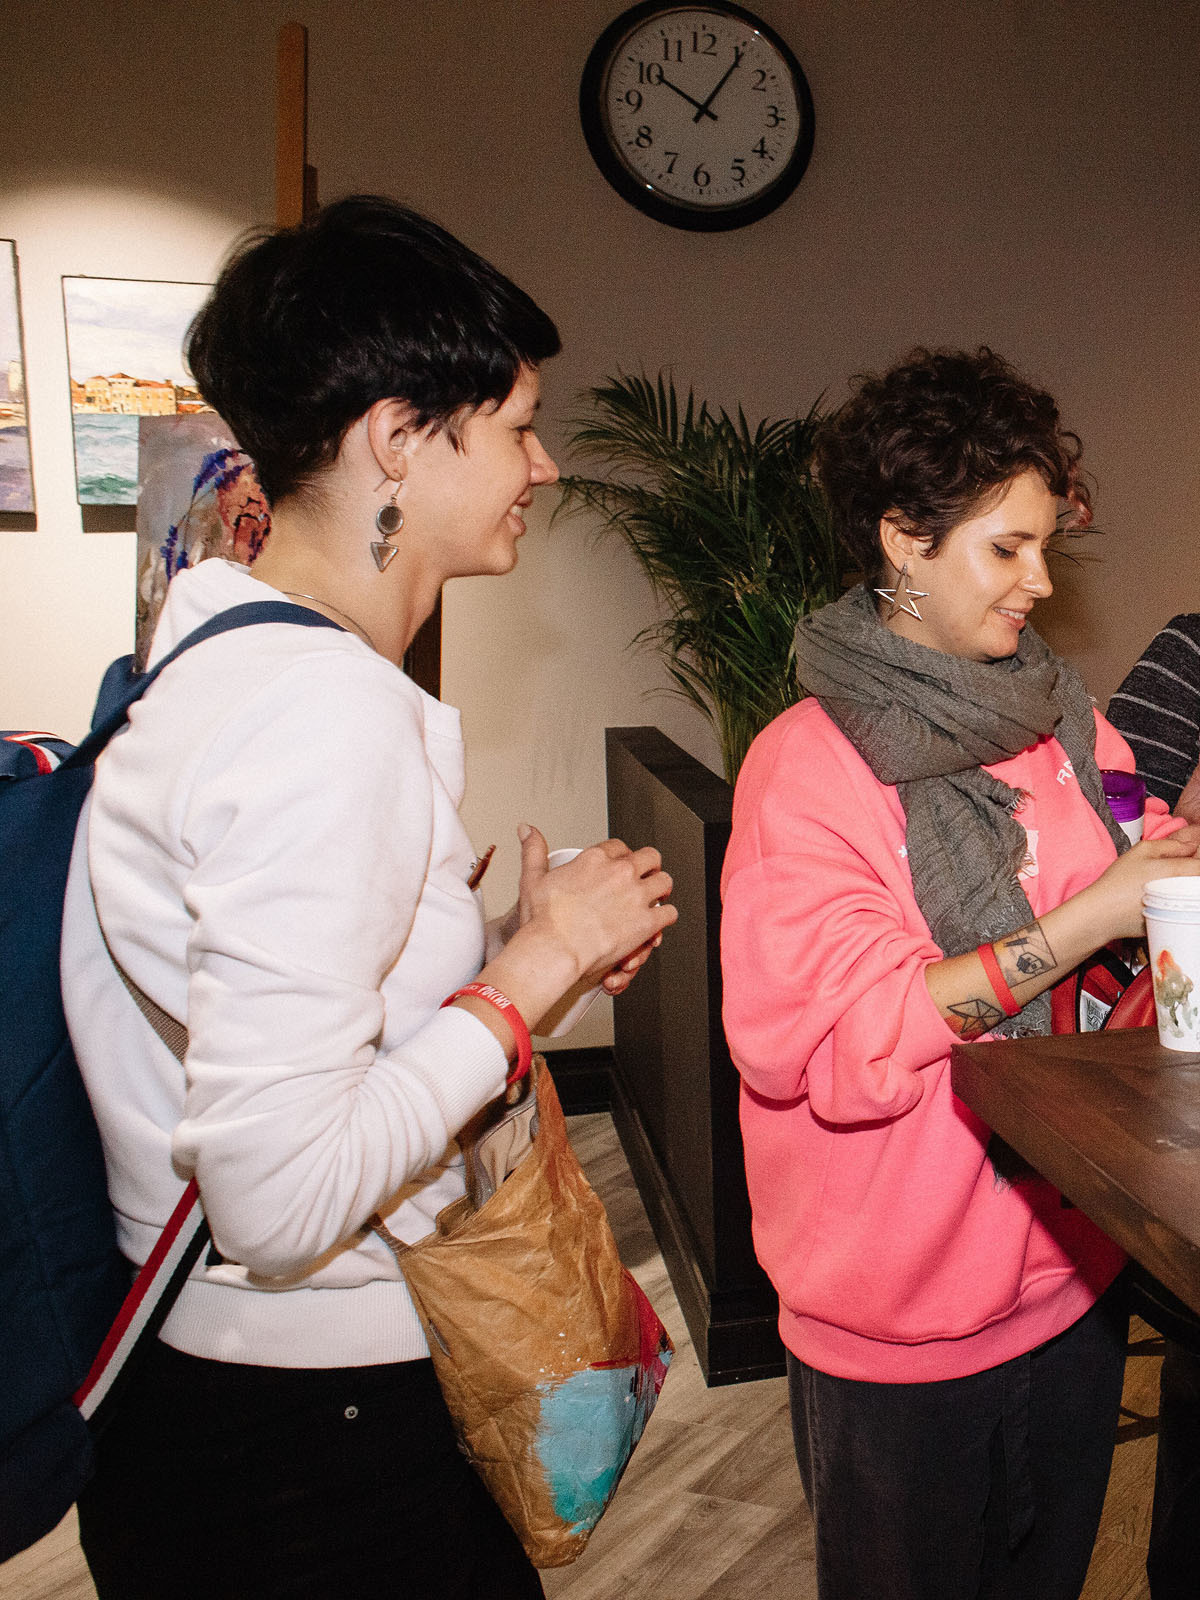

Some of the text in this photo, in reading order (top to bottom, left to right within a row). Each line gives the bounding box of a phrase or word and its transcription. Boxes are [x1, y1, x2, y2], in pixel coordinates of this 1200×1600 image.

[663, 39, 682, 62] 11
[692, 31, 717, 56] 12
[638, 62, 664, 86] 10
[752, 69, 766, 92] 2
[625, 89, 643, 114] 9
[765, 105, 779, 128] 3
[635, 125, 653, 148] 8
[752, 137, 768, 158] 4
[665, 151, 679, 174] 7
[731, 159, 745, 181] 5
[693, 163, 711, 187] 6
[477, 985, 512, 1009] РОССИЯ
